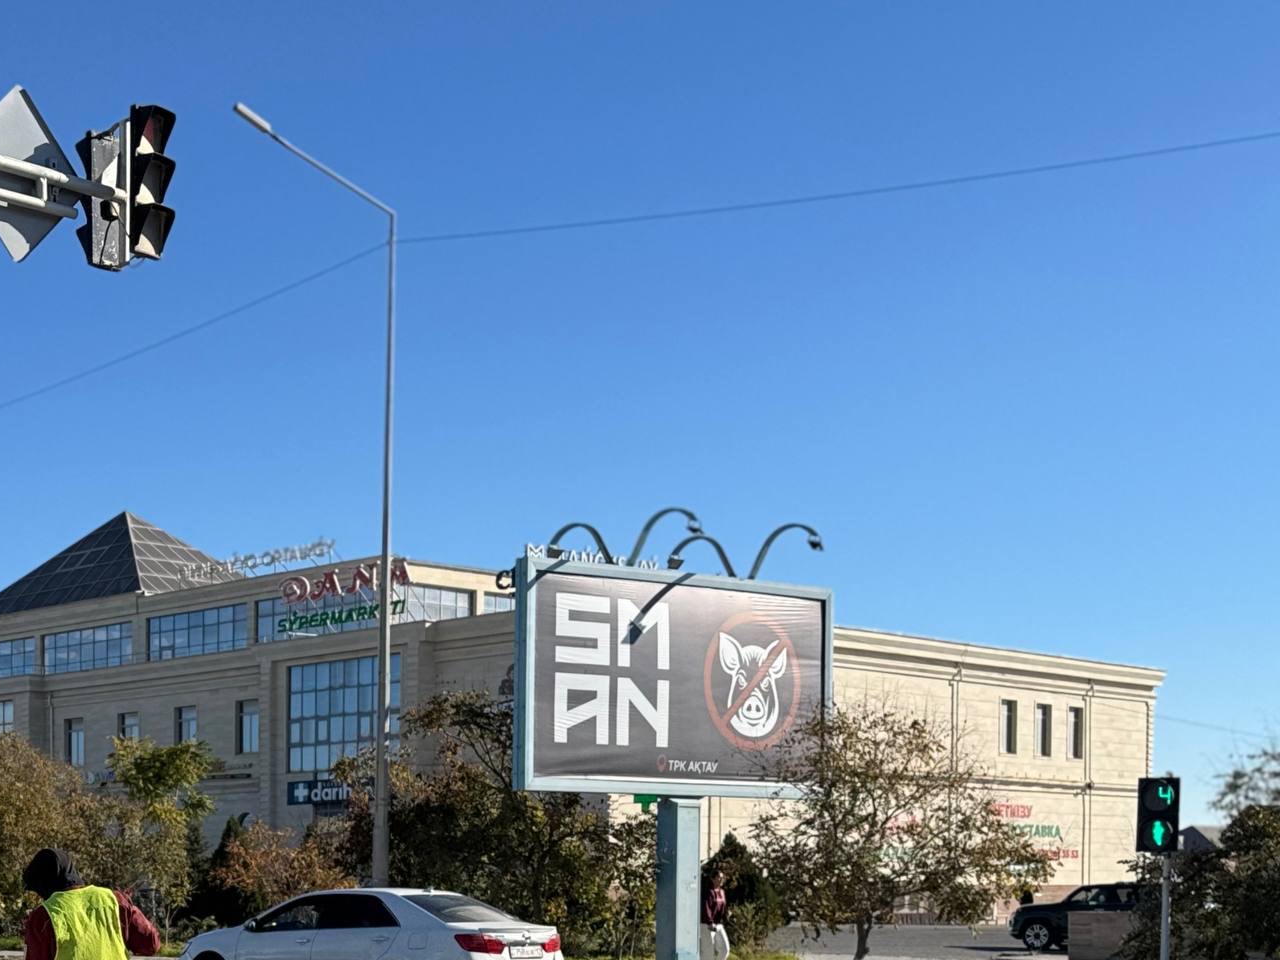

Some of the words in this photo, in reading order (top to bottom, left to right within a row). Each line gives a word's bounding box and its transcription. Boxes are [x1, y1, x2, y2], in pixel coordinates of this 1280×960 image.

[277, 599, 406, 633] SÝPERMARKTI
[669, 760, 686, 771] ТРК
[1158, 785, 1171, 805] 4
